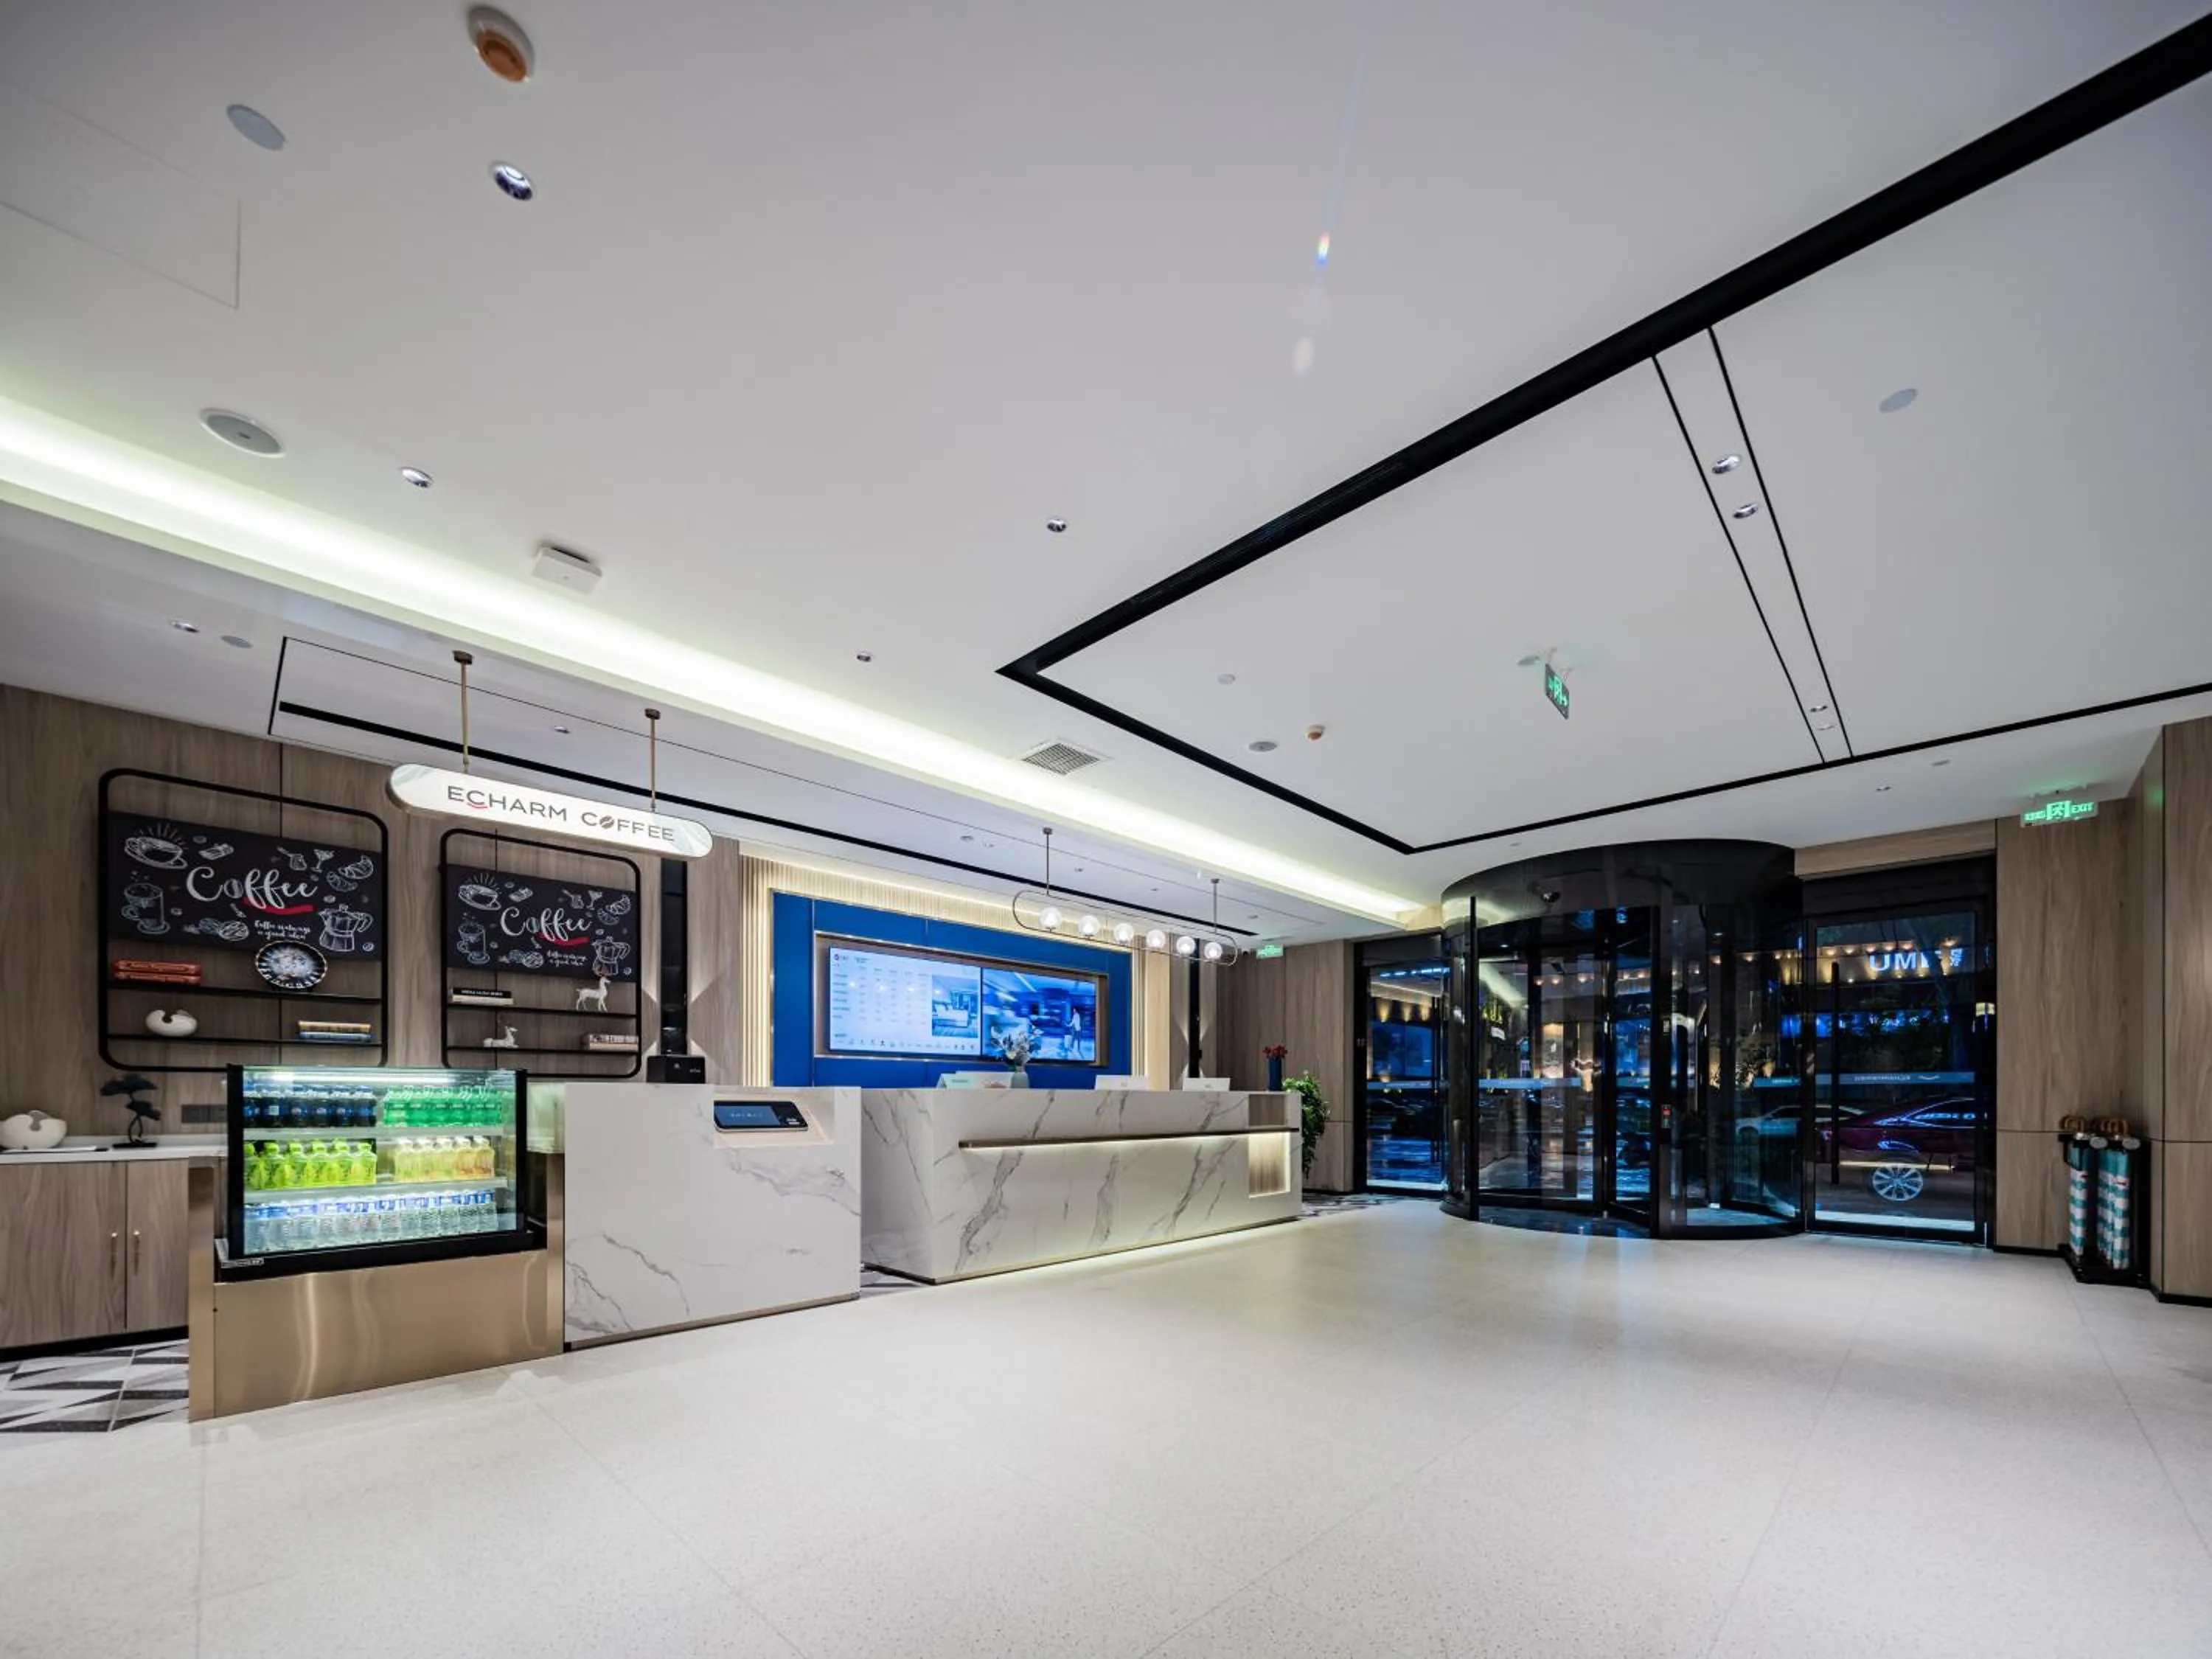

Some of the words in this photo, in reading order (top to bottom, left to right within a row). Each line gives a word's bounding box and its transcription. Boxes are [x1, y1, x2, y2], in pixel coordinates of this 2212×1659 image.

[448, 785, 567, 821] ECHARM
[581, 811, 675, 842] COFFEE
[2071, 801, 2095, 813] EXIT
[187, 866, 318, 909] Coffee
[501, 906, 592, 942] Coffee
